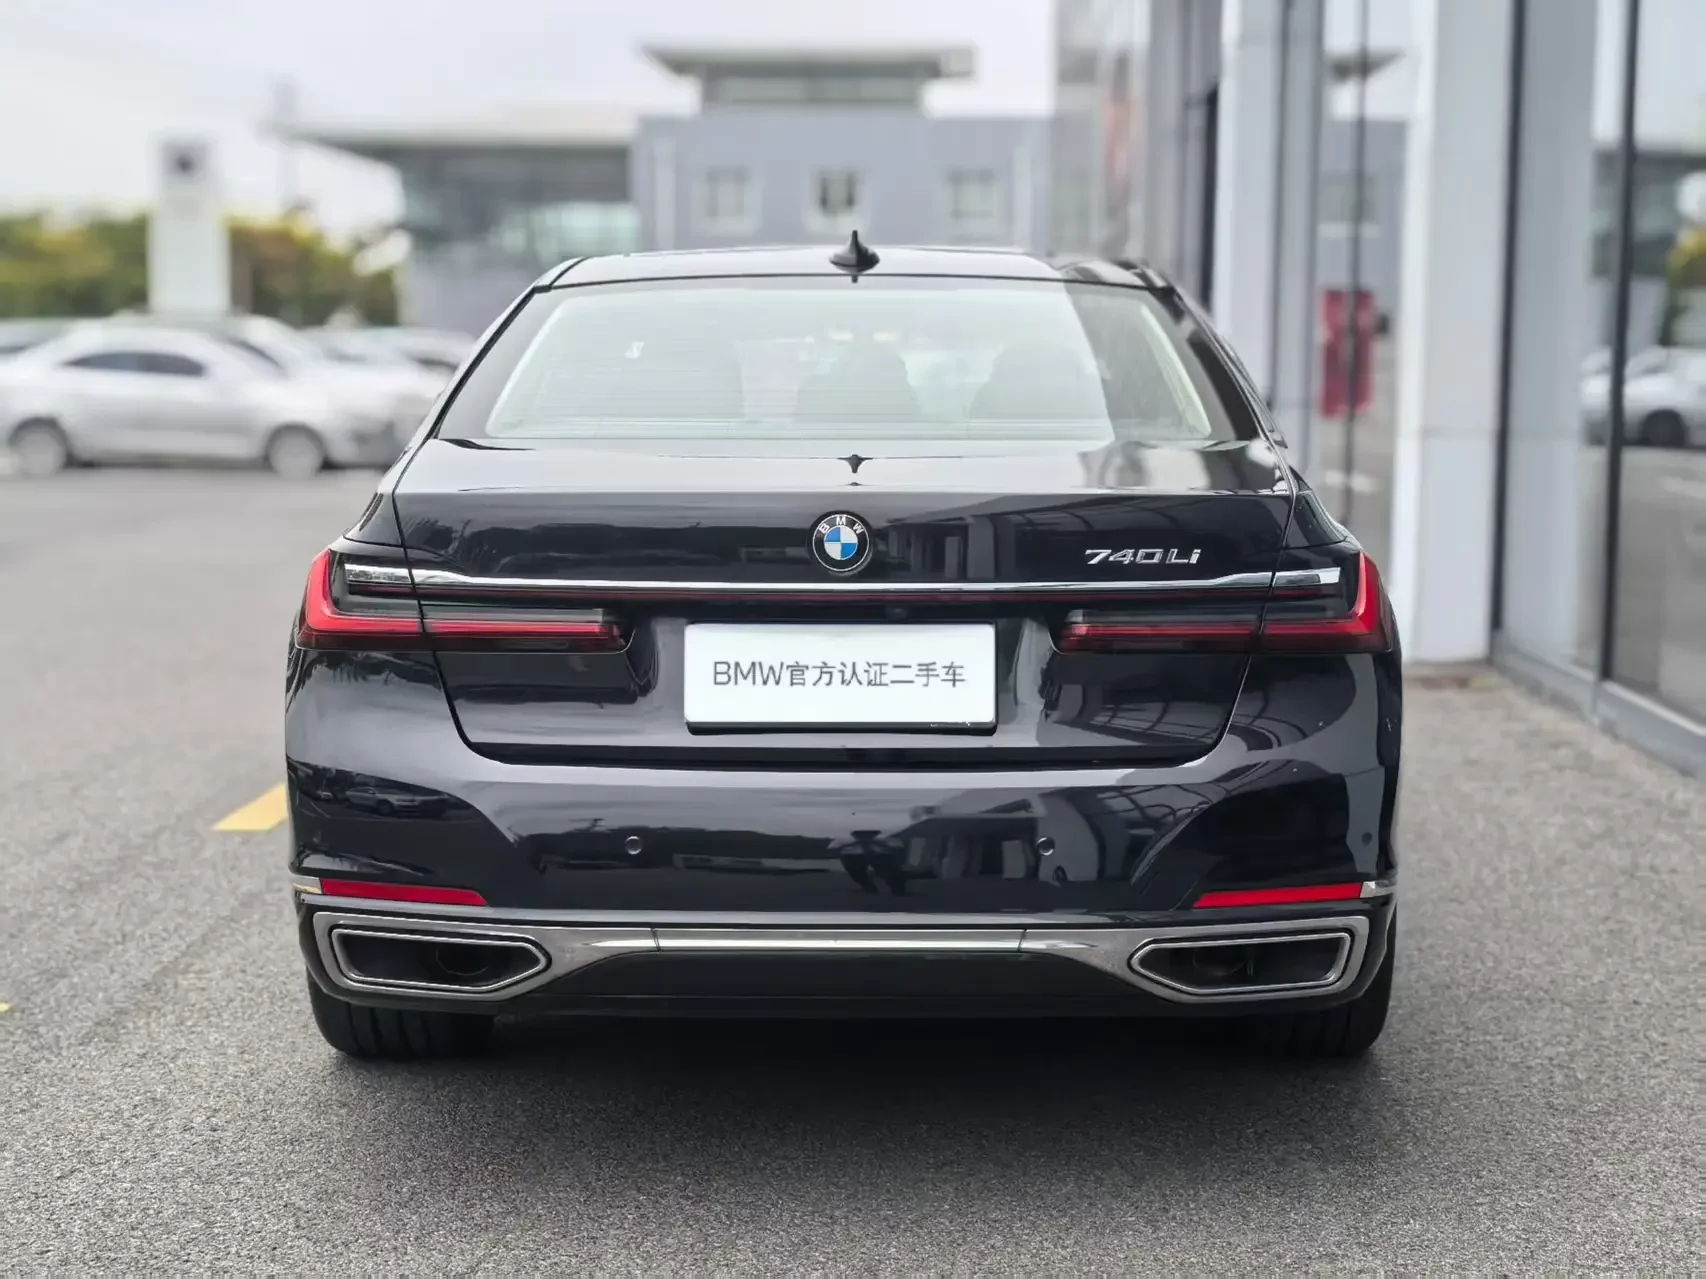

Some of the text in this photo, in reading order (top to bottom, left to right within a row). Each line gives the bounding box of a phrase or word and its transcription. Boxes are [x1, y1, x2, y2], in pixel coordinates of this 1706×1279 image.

[819, 515, 864, 534] BMW
[1085, 548, 1201, 565] 740Li
[713, 660, 966, 687] BMW官方认证二手车
